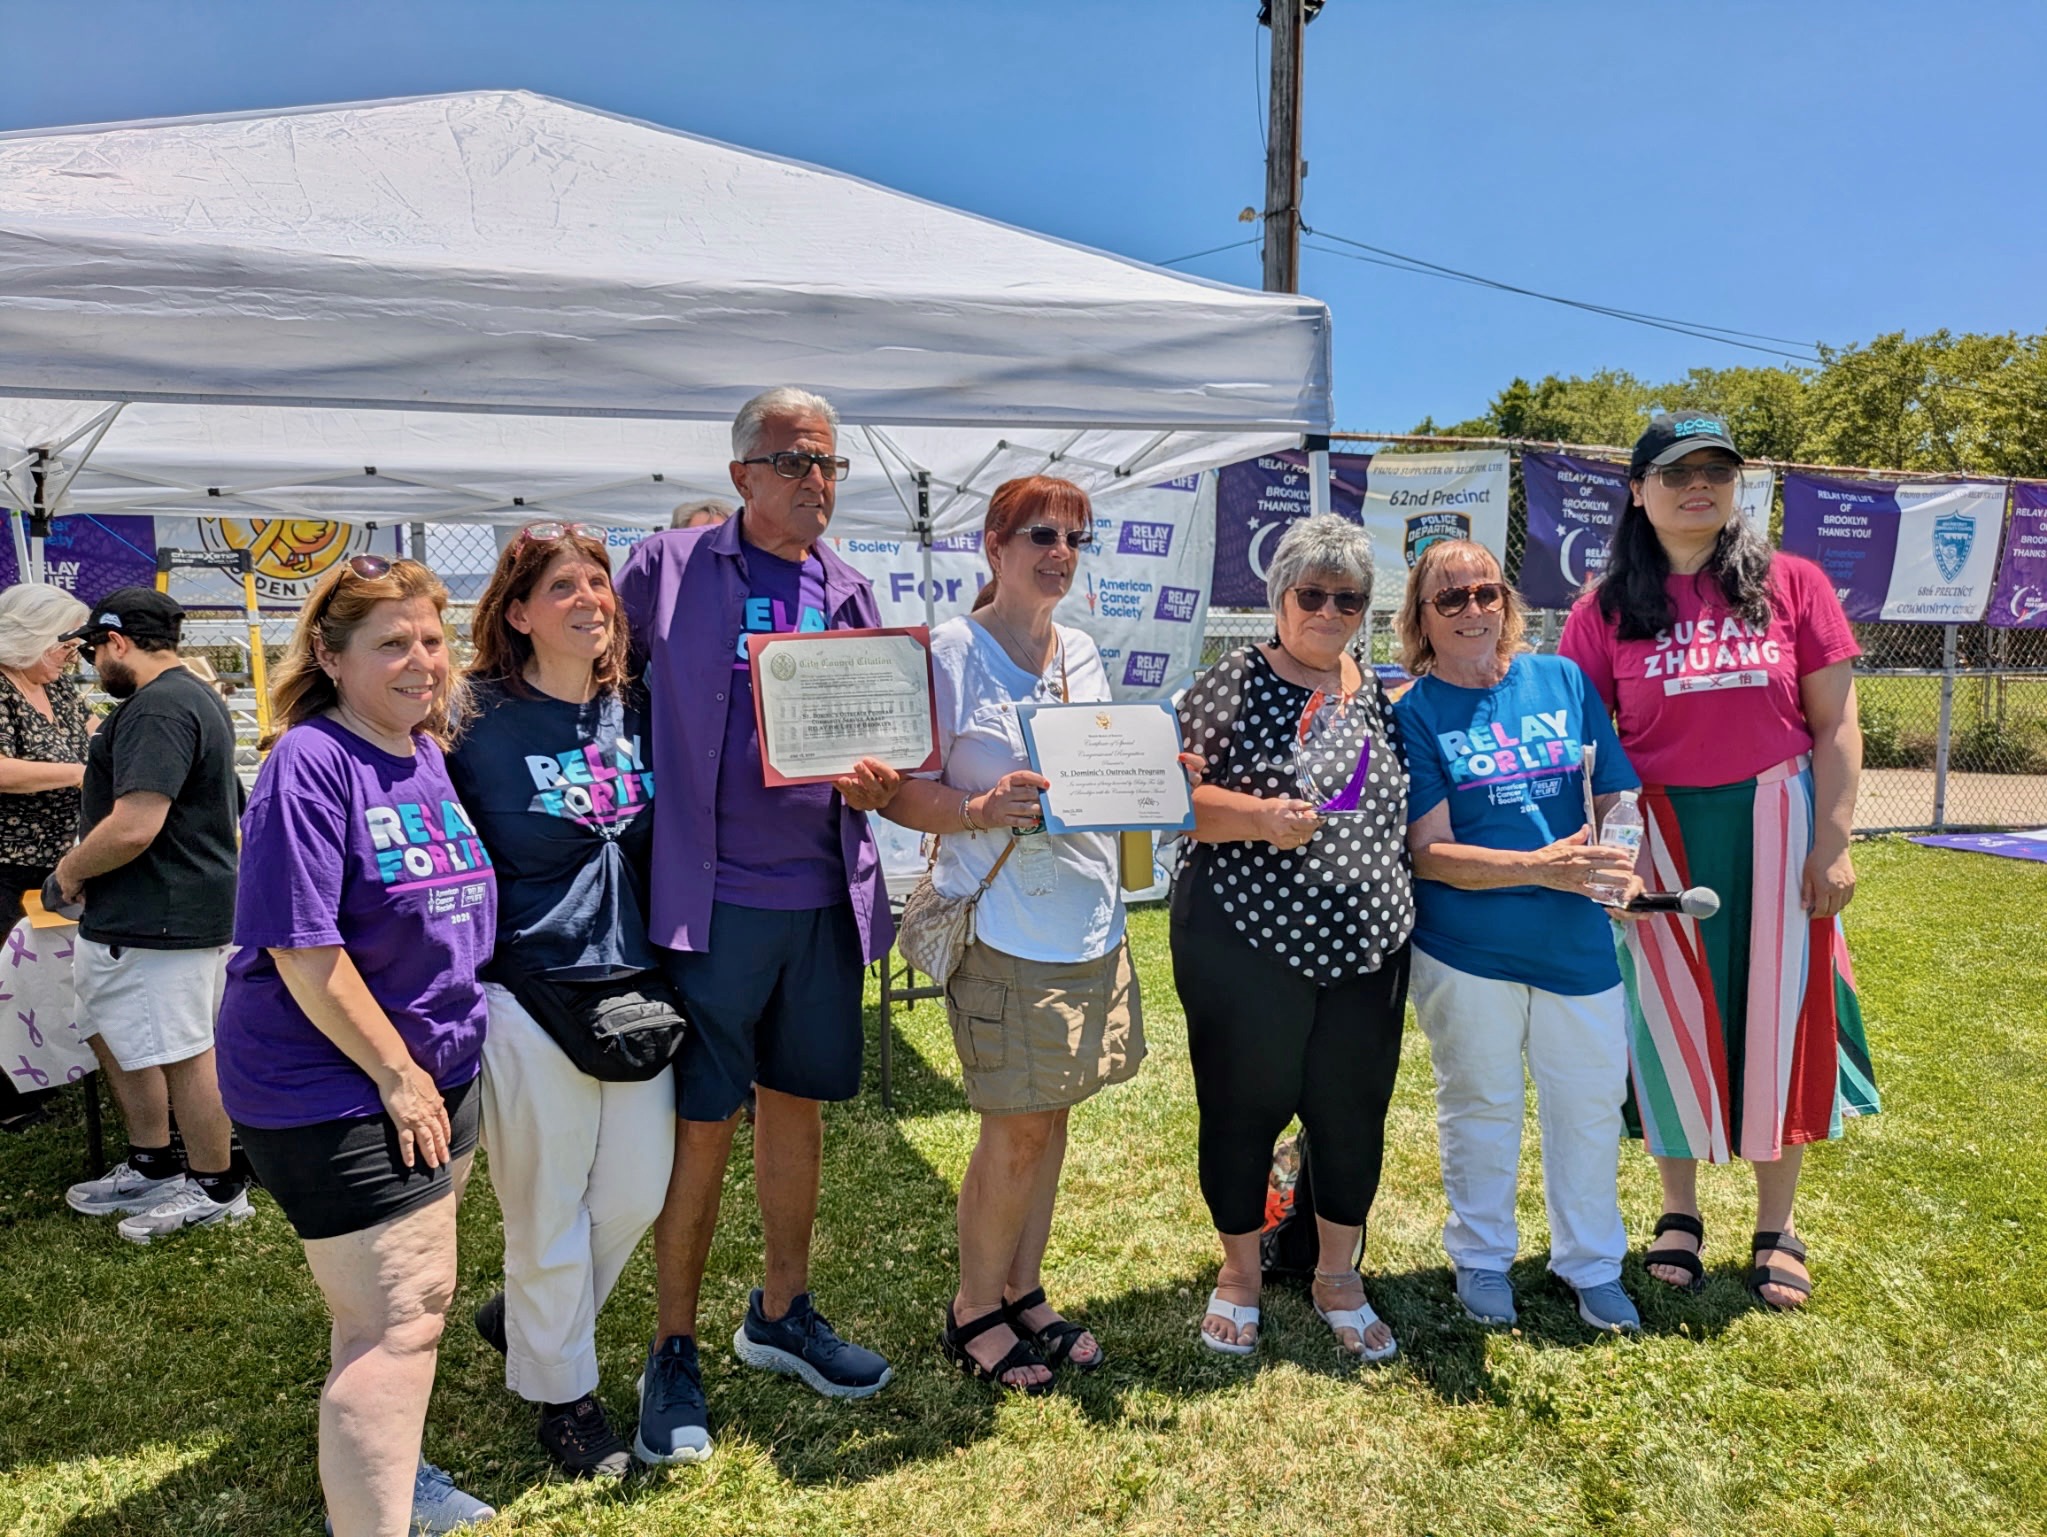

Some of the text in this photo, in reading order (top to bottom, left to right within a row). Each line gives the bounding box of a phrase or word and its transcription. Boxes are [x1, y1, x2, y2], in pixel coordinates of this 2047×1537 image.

[1258, 459, 1290, 471] RELAY
[1284, 475, 1298, 485] OF
[1558, 471, 1586, 482] RELAY
[1266, 486, 1310, 500] BROOKLY
[1390, 489, 1490, 506] 62nd Precinct
[1580, 487, 1593, 496] OF
[1818, 490, 1840, 500] RELAY
[1258, 500, 1300, 512] THANKS
[1562, 498, 1609, 511] BROOKLYN
[1840, 504, 1852, 512] OF
[2016, 508, 2044, 517] RELAY
[1420, 514, 1458, 526] POLICE
[1592, 514, 1613, 525] YOU!
[1824, 515, 1868, 525] BROOKLYN
[1132, 525, 1169, 540] RELAY
[1408, 524, 1467, 540] DEPARTMENT
[1817, 527, 1871, 538] THANKS YOU!
[848, 540, 900, 556] Society
[947, 538, 975, 550] LIFE
[1142, 539, 1167, 553] LIFE
[2013, 549, 2046, 557] THANKS
[889, 572, 962, 603] For
[1099, 578, 1152, 592] American
[1918, 584, 1974, 597] 68th PRECINCT
[1100, 591, 1141, 604] Cancer
[1168, 590, 1196, 606] RELAY
[1102, 604, 1144, 621] Society
[1164, 604, 1192, 619] FOR LIFE
[1897, 602, 1950, 615] COMMUNITY
[1656, 617, 1765, 651] SUSAN
[1136, 656, 1166, 669] RELAY
[1644, 640, 1780, 678] ZHUANG
[1143, 670, 1162, 684] LIFE
[1437, 710, 1568, 762] RELAY
[1449, 739, 1580, 783] FOR LIFE
[1106, 768, 1136, 776] Outreach
[1138, 768, 1165, 776] Program
[1496, 782, 1527, 792] American
[540, 782, 616, 817] FOR
[1496, 790, 1522, 798] Cancer
[1498, 796, 1524, 805] Society
[365, 800, 477, 850] RELAY
[376, 844, 451, 884] FOR
